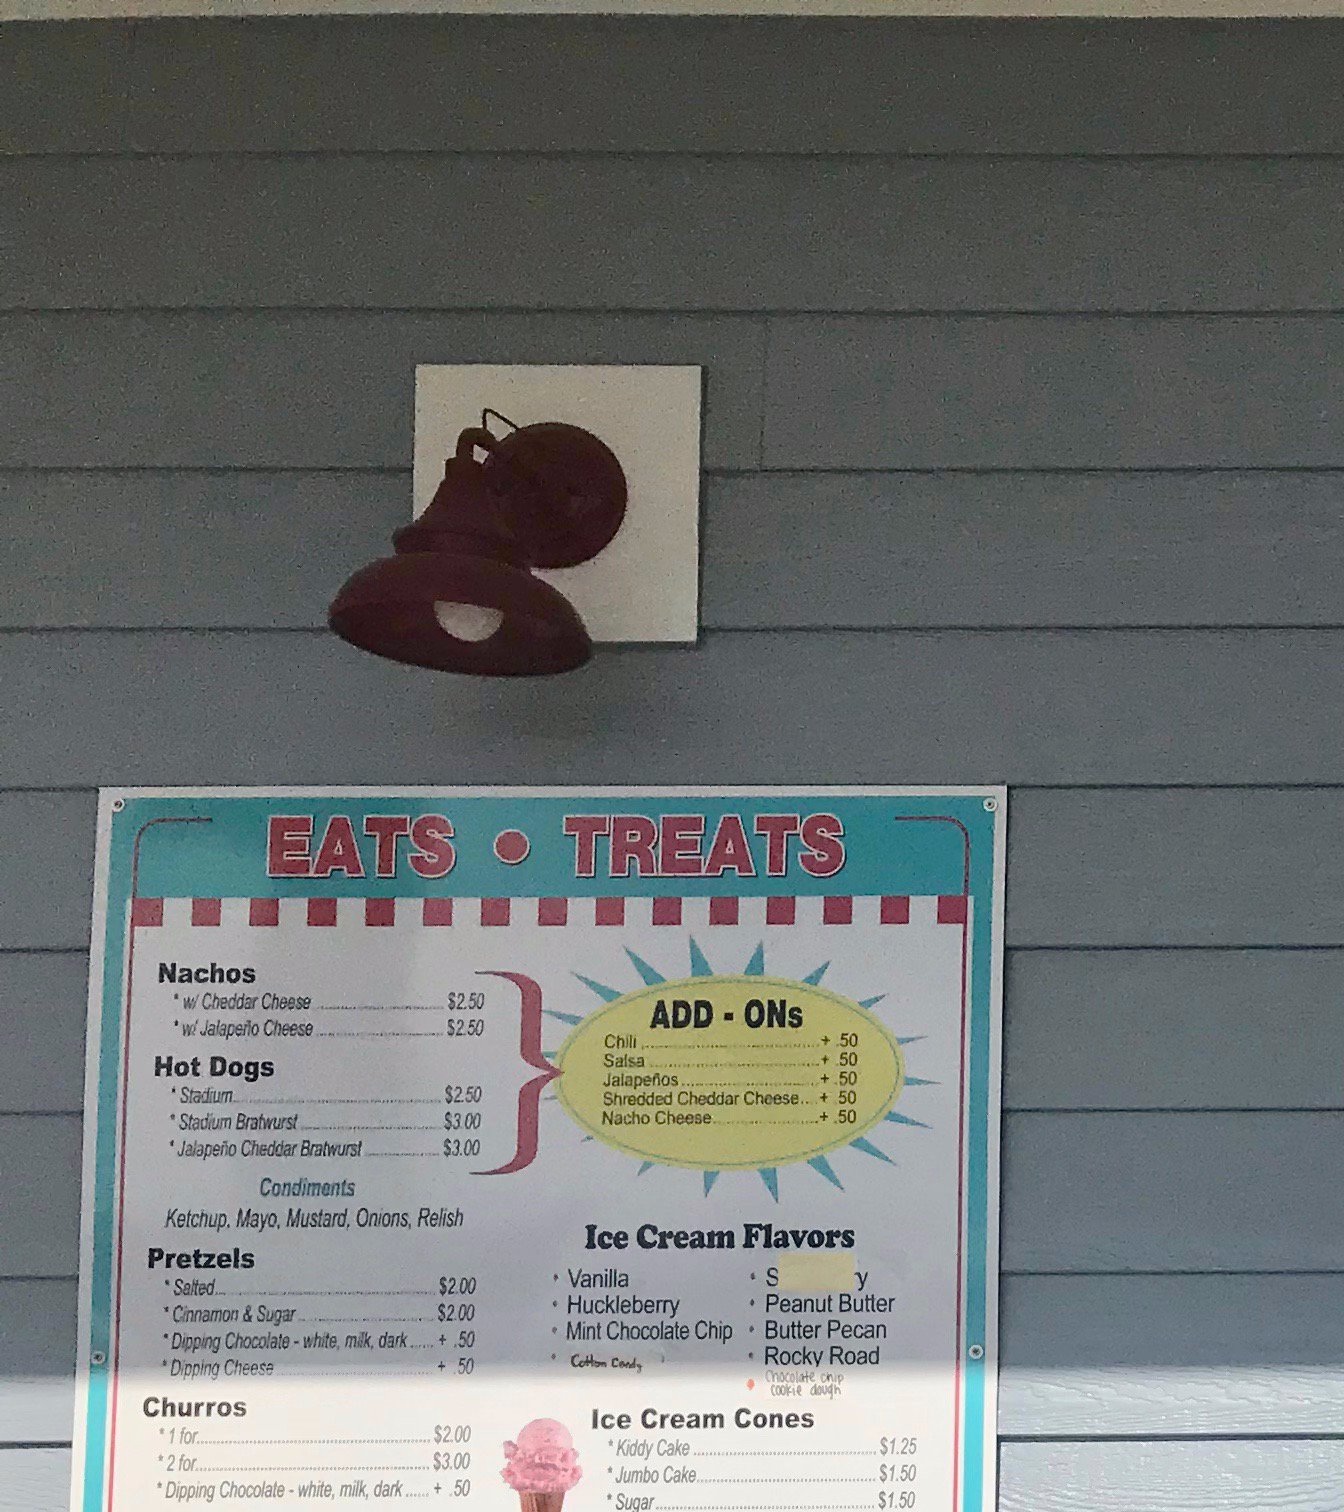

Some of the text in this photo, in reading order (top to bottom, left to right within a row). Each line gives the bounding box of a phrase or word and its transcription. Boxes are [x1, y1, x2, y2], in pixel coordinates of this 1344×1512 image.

[265, 812, 847, 880] EATS TREATS
[159, 963, 255, 983] Nachos
[650, 999, 803, 1029] ADD ONs
[605, 1034, 636, 1049] Chili
[155, 1056, 274, 1082] Hot Dogs
[604, 1053, 644, 1068] Salsa
[603, 1073, 678, 1090] Jalapeños
[260, 1178, 355, 1197] Condiments
[585, 1223, 854, 1249] Ice Cream Flavors
[148, 1248, 254, 1269] Pretzels
[568, 1269, 628, 1288] Vanilla
[568, 1295, 680, 1318] Huckleberry
[766, 1293, 895, 1313] Peanut Butter
[566, 1320, 732, 1344] Mint Chocolate Chip
[765, 1346, 879, 1367] Rocky Road
[143, 1397, 246, 1417] Churros
[592, 1408, 814, 1429] Ice Cream Cones
[616, 1439, 690, 1460] Kiddy Cake
